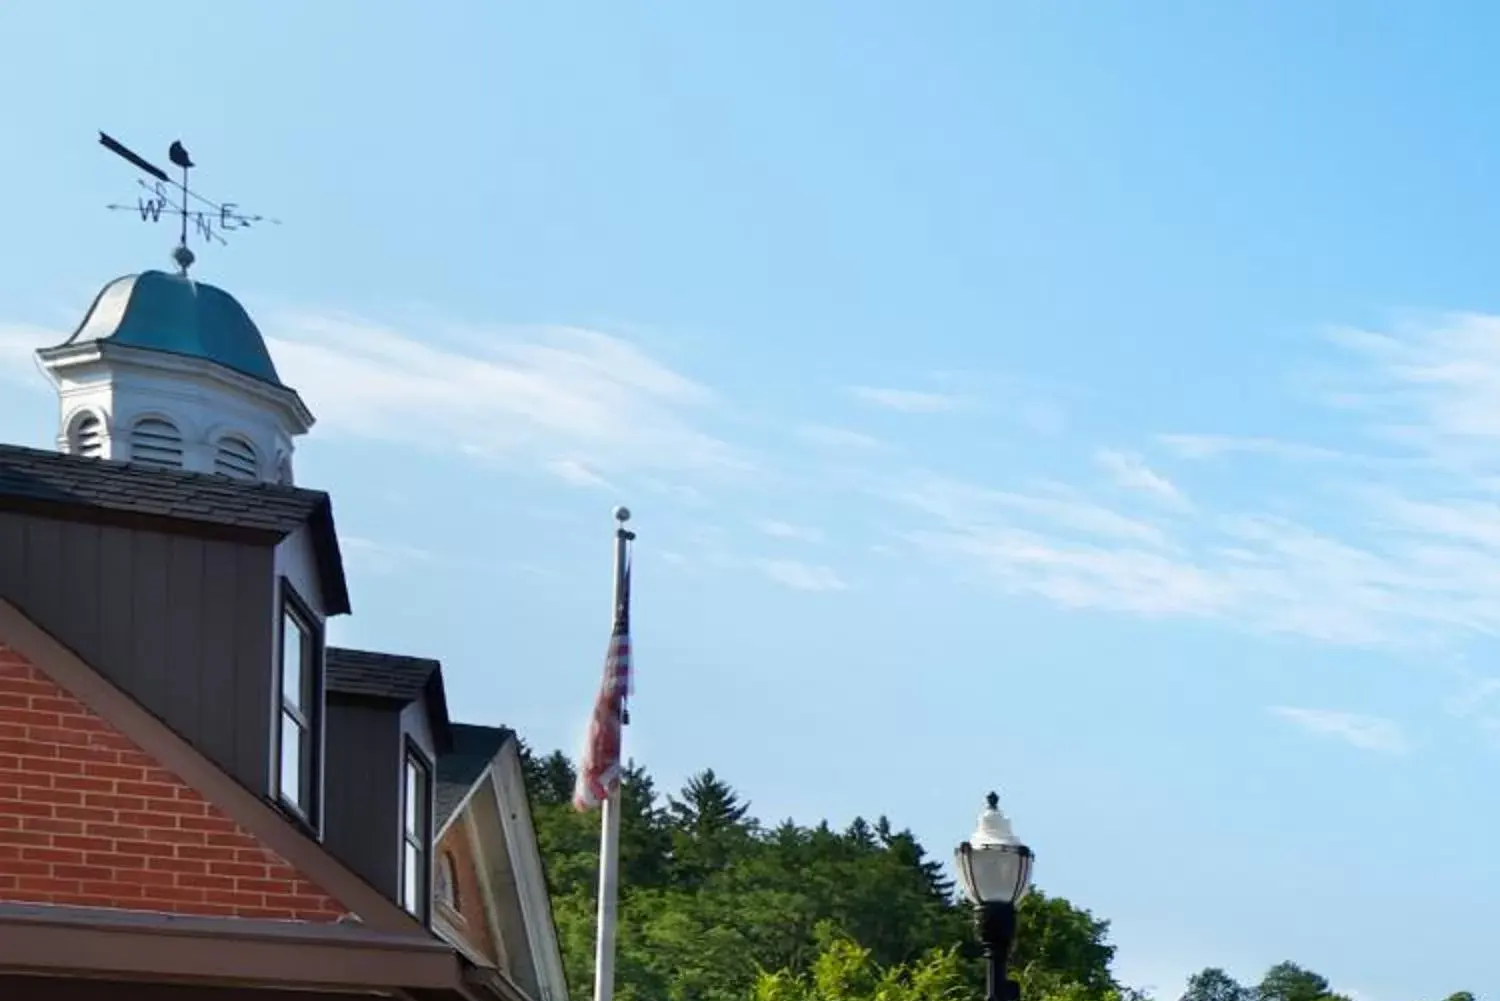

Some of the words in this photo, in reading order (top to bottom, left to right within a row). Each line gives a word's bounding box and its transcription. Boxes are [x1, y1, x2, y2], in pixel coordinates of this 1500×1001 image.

[138, 197, 162, 222] W
[221, 202, 238, 229] E
[196, 212, 211, 242] N
